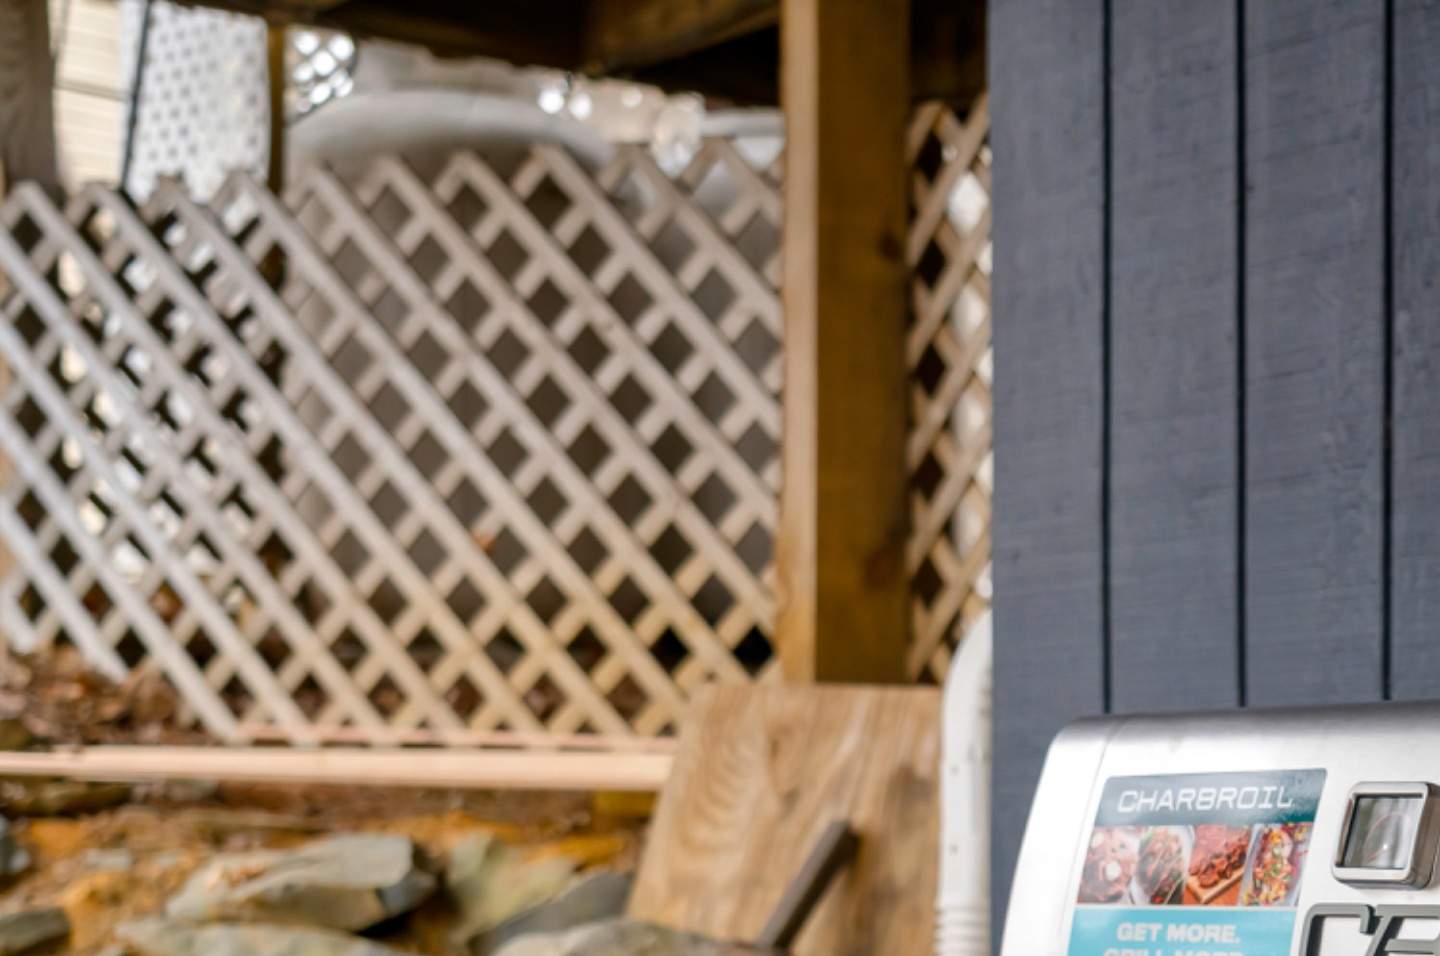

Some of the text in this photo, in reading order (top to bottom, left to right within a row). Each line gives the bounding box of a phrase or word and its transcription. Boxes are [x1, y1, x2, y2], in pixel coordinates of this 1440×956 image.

[1117, 785, 1297, 814] CHARBROIL
[1116, 922, 1241, 944] GET MORE.
